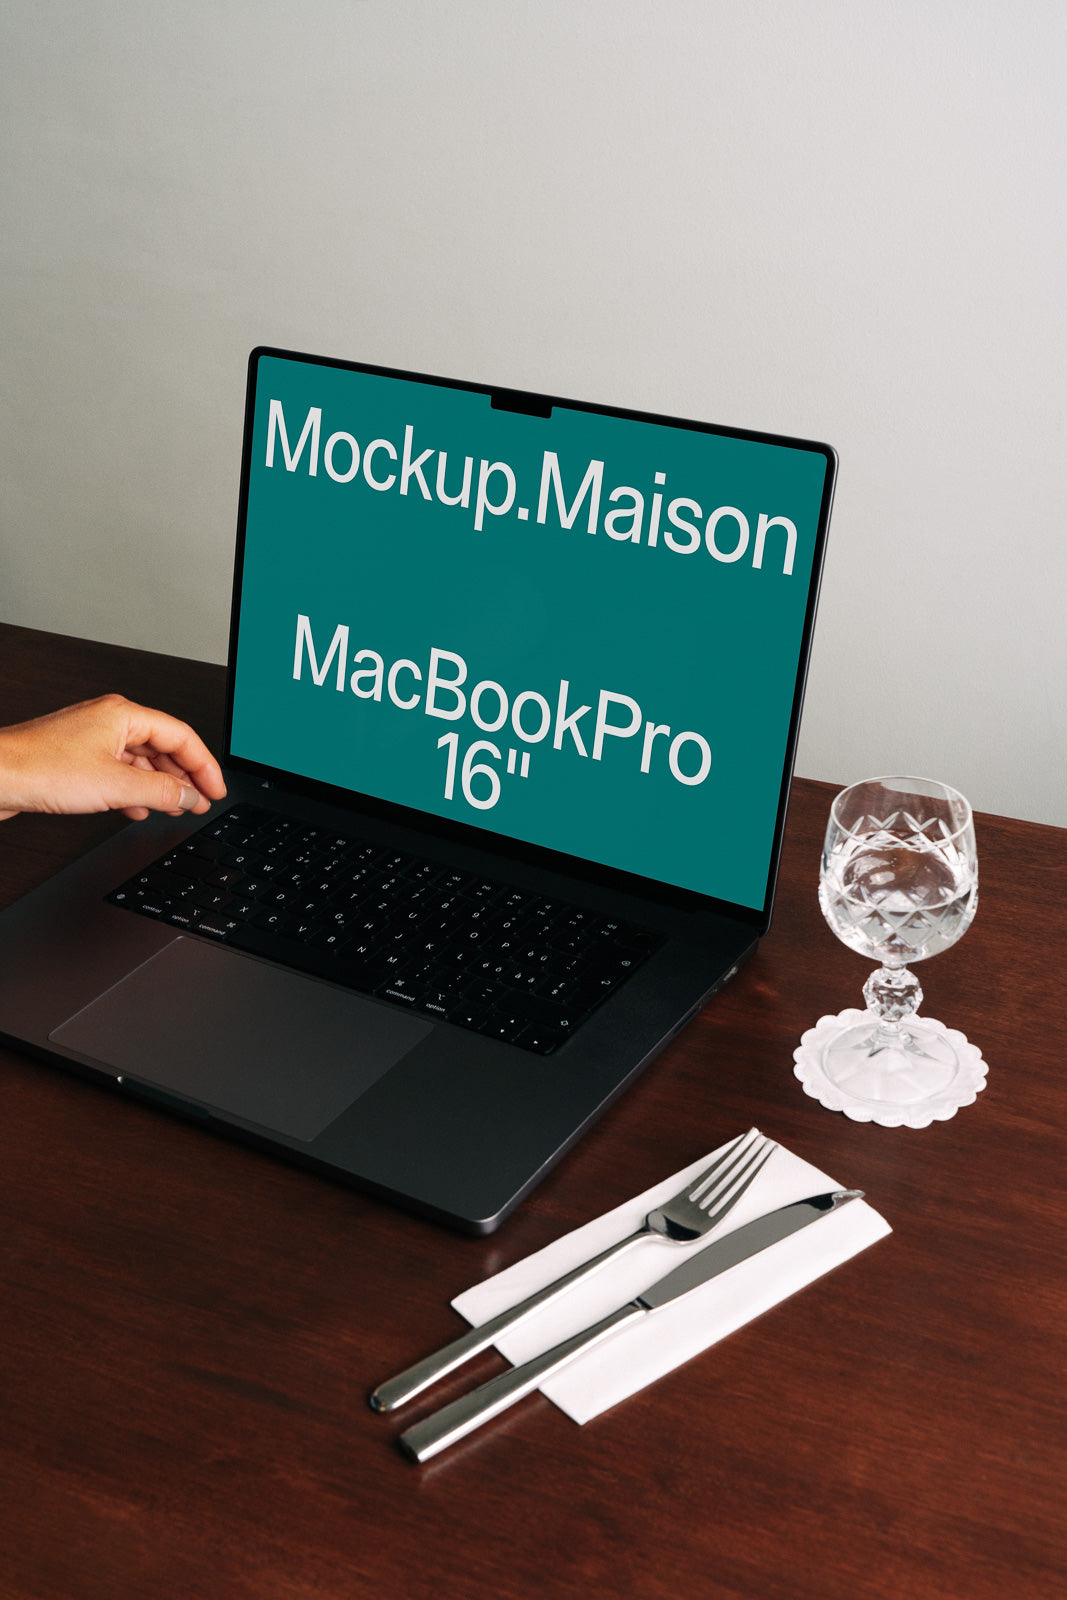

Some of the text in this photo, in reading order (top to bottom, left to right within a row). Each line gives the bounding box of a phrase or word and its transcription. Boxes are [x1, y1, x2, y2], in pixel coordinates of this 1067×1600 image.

[266, 399, 797, 575] Mockup.Maison
[293, 614, 711, 785] MacBookPro
[438, 732, 530, 809] 16"
[198, 923, 227, 936] command
[385, 988, 416, 1002] command
